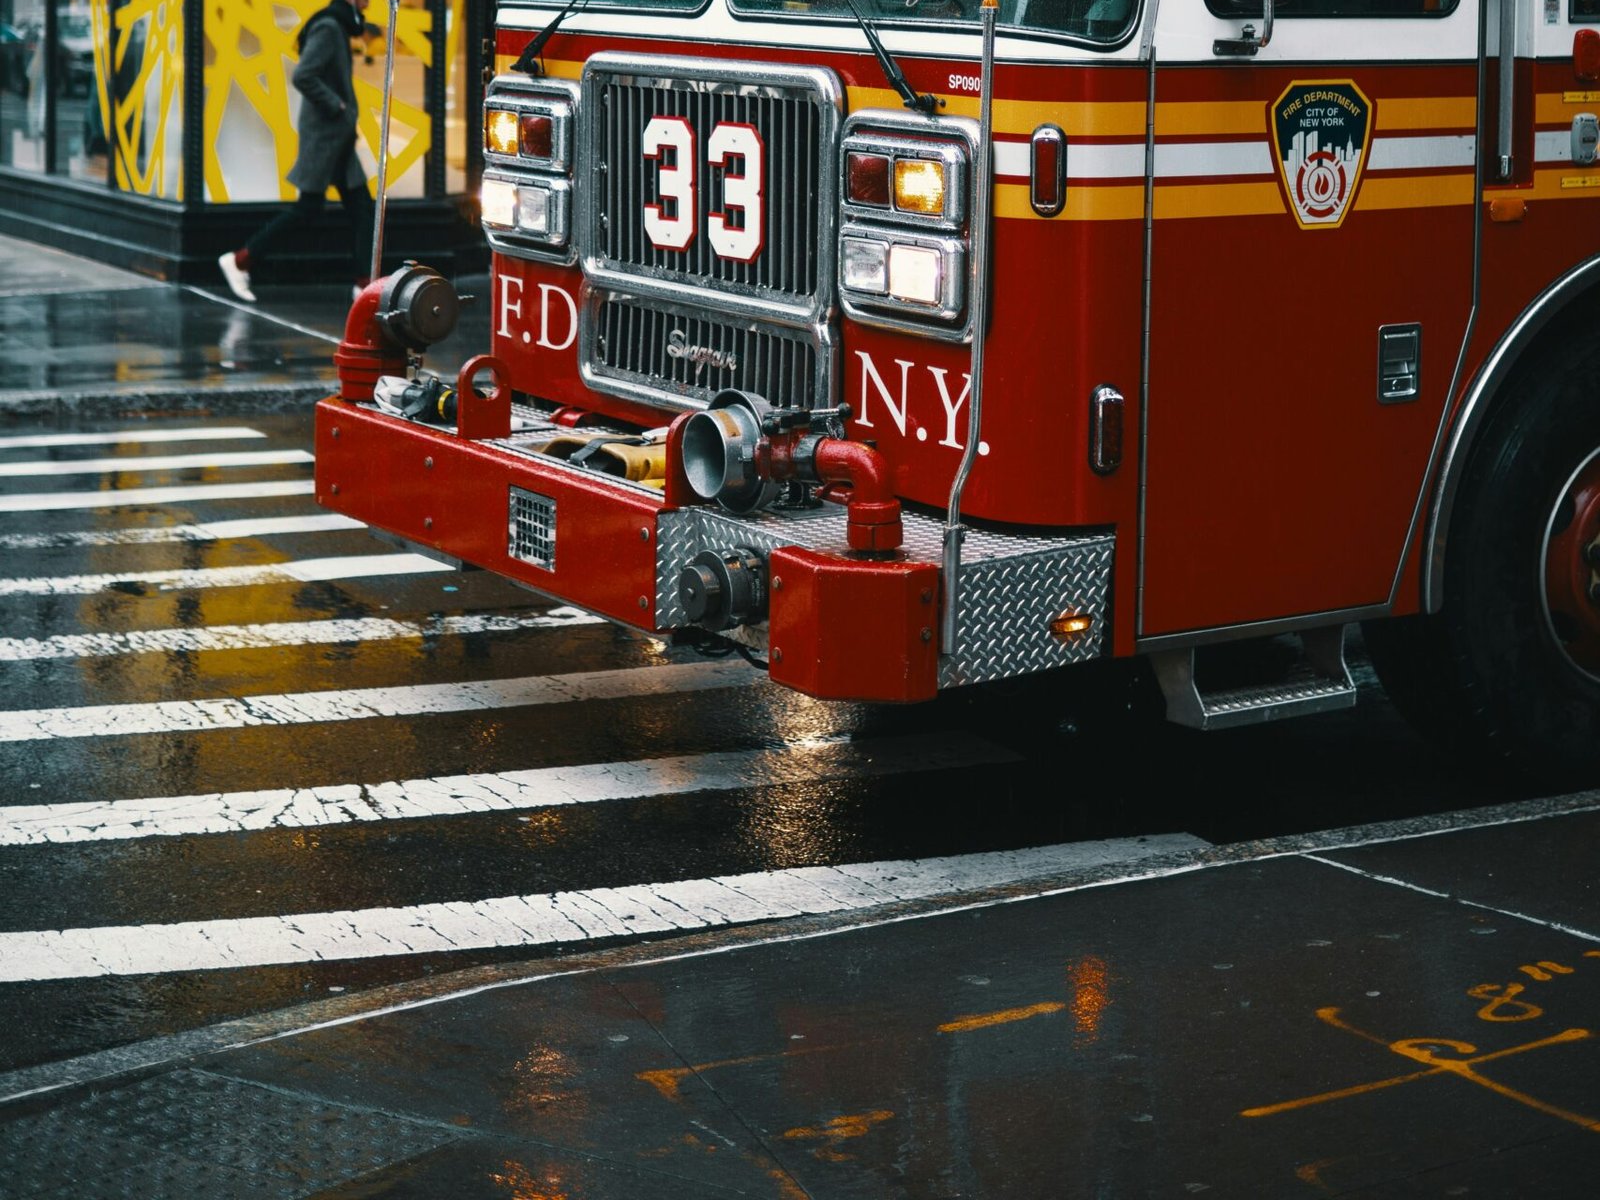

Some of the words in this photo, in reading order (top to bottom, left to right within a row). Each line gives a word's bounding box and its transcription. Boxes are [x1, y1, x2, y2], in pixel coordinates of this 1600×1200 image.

[948, 74, 982, 92] SP090
[1282, 99, 1303, 119] FIRE
[1304, 92, 1361, 117] DEPARTMENT
[1306, 108, 1325, 117] CITY
[1327, 108, 1339, 116] OF
[1300, 118, 1319, 127] NEW
[1321, 117, 1344, 126] YORK
[642, 114, 765, 264] 33
[854, 350, 991, 456] N.Y.
